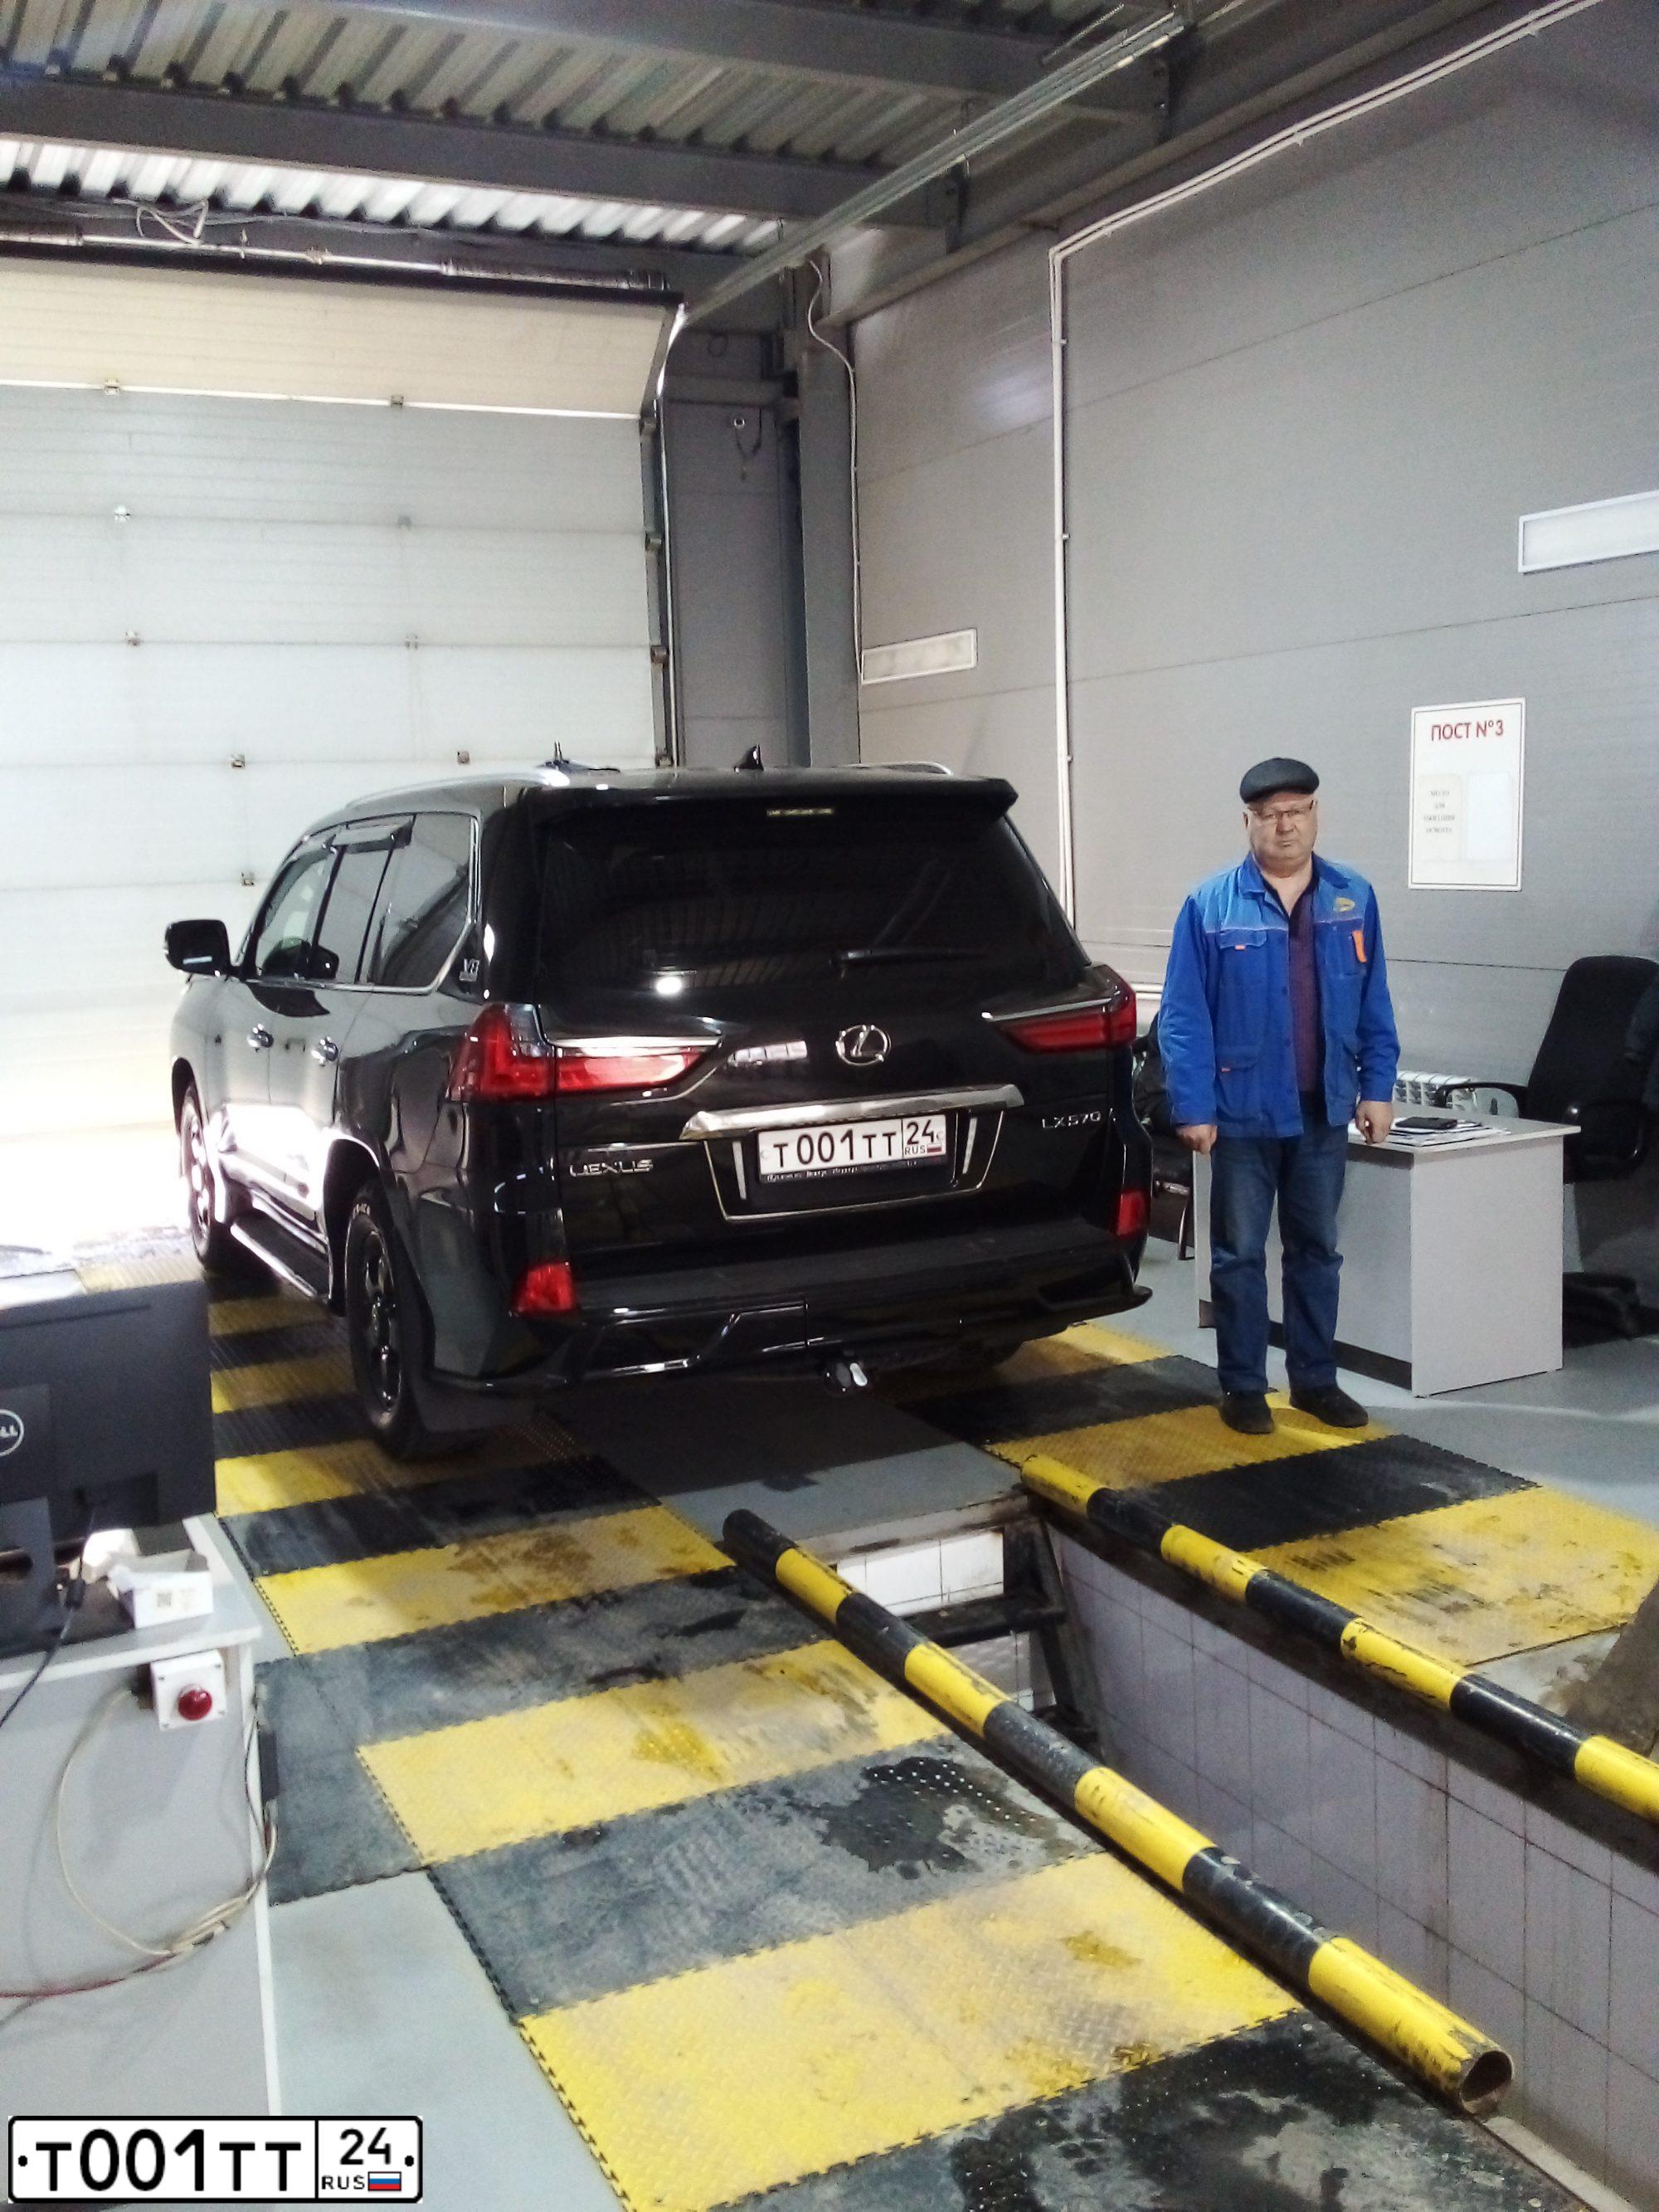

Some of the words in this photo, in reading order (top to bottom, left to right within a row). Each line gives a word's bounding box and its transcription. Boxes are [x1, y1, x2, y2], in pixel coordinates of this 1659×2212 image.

[1431, 722, 1472, 742] ПОСТ
[907, 1119, 934, 1145] 24
[904, 1145, 927, 1156] RUS
[569, 1159, 654, 1177] LEXUS
